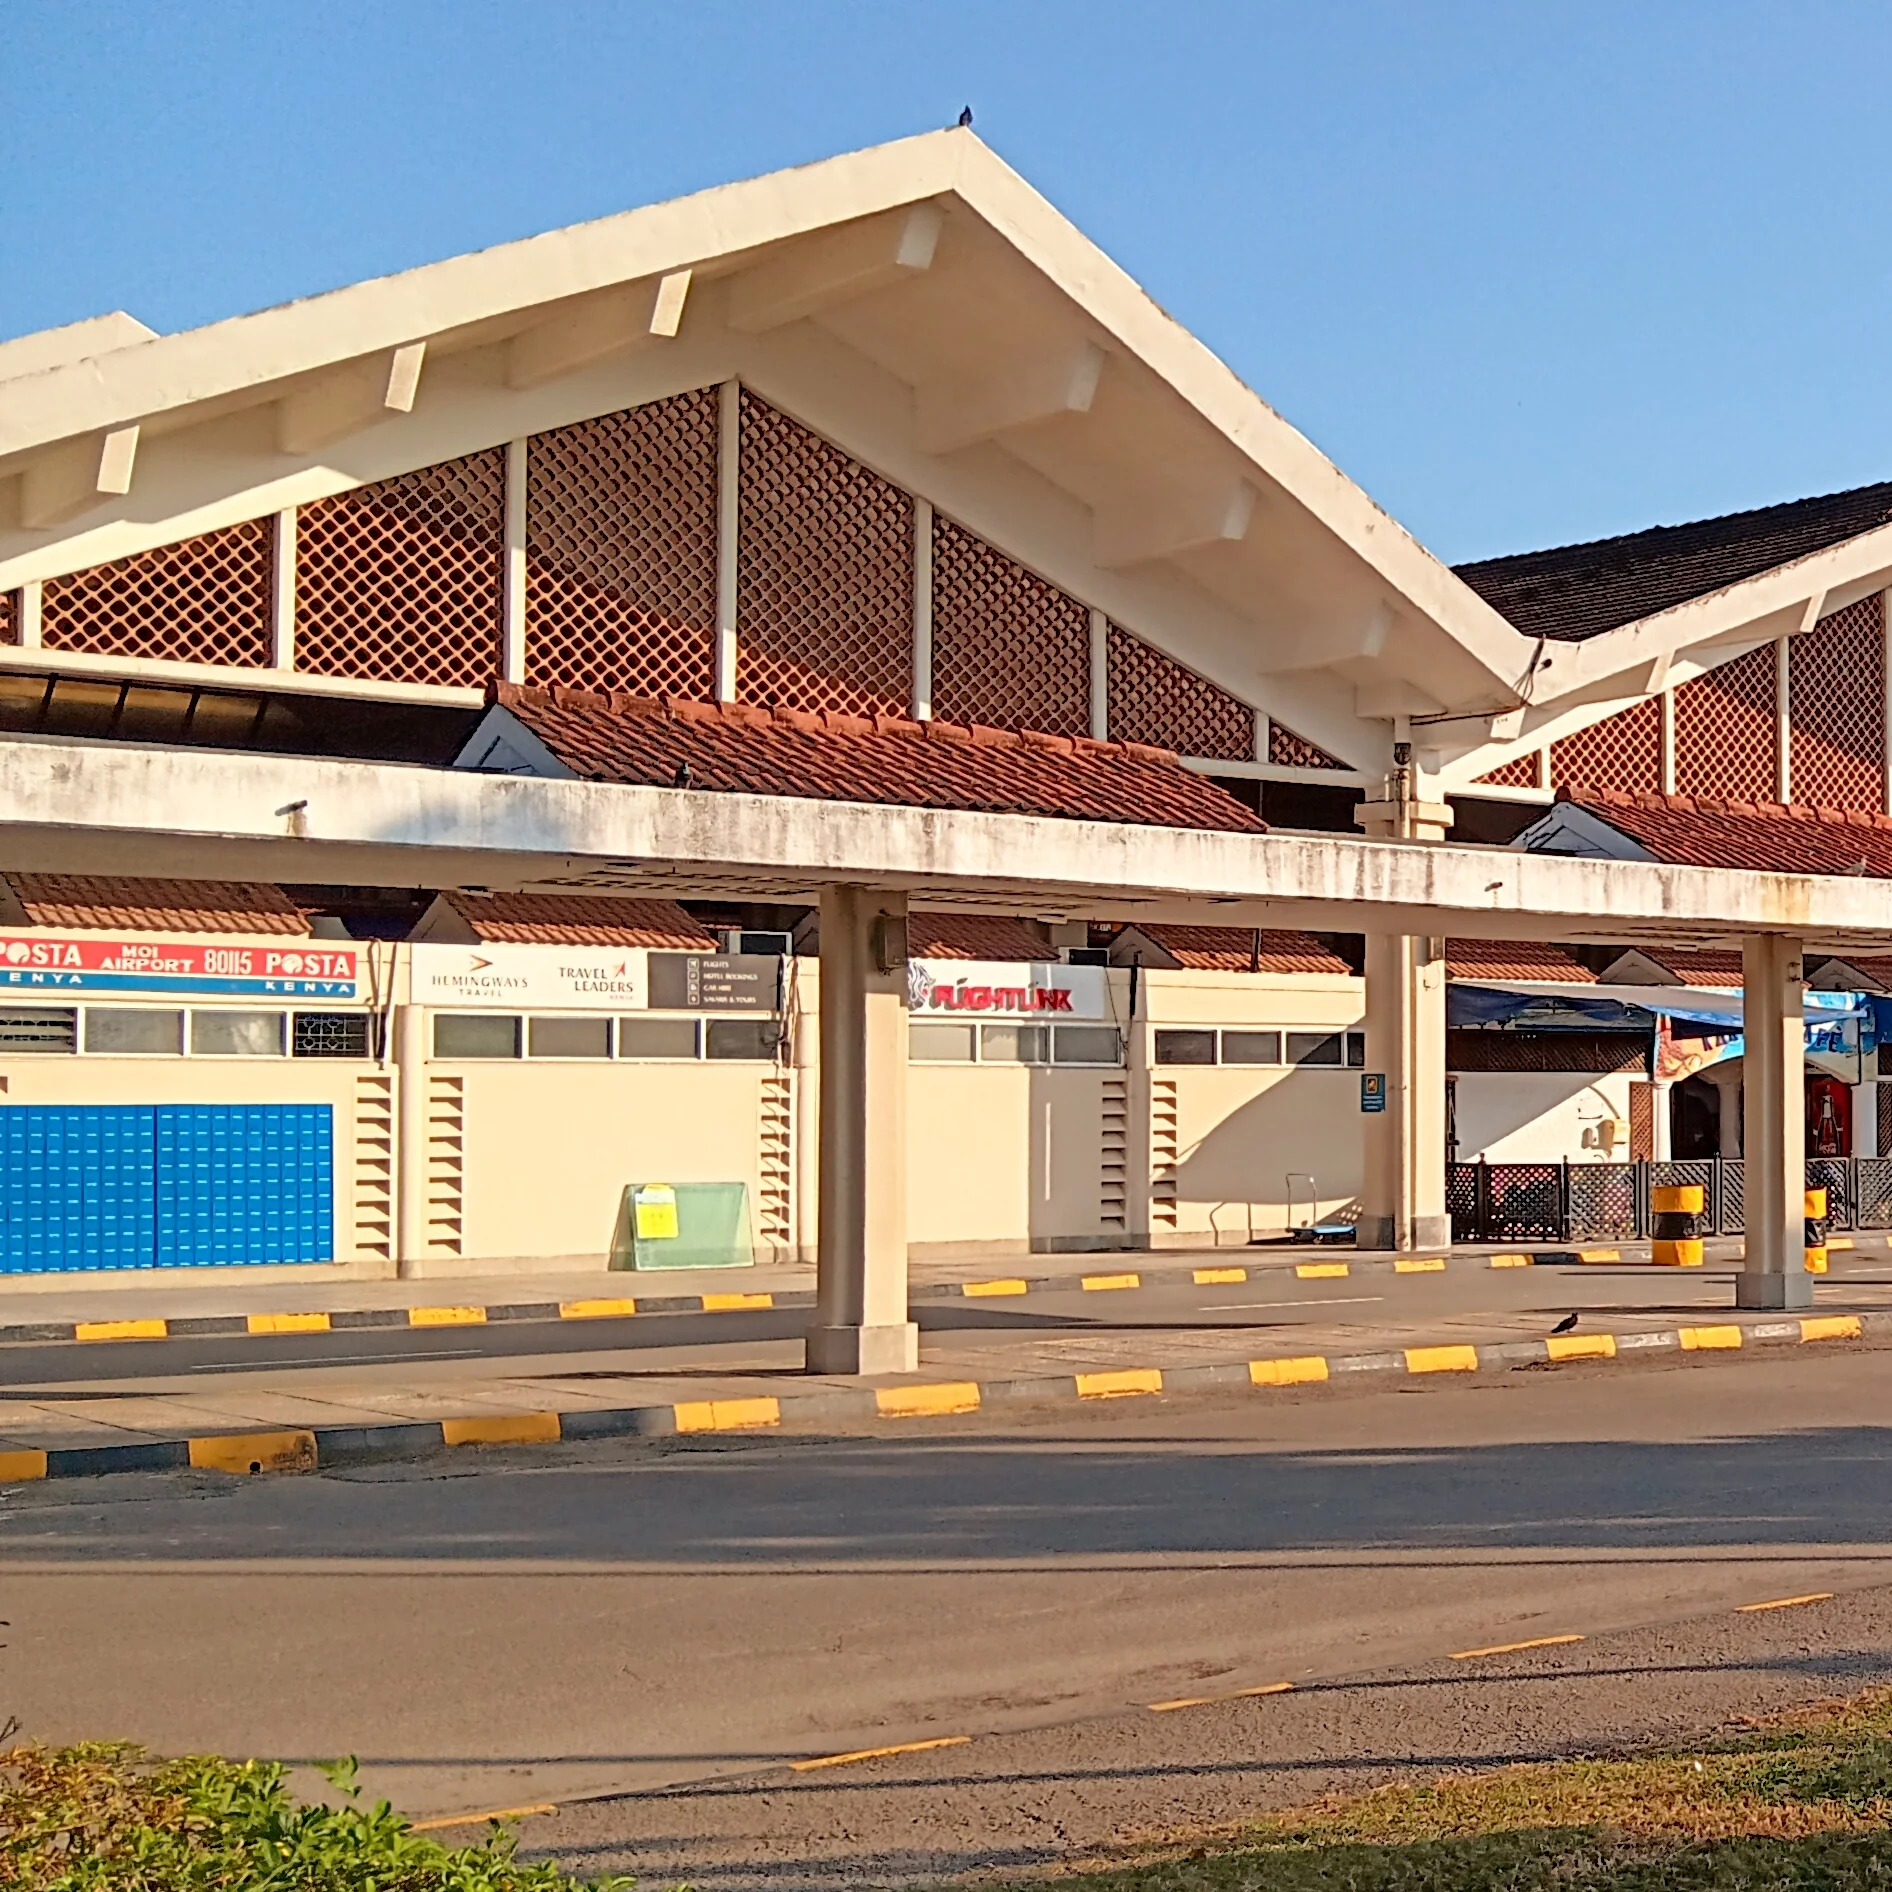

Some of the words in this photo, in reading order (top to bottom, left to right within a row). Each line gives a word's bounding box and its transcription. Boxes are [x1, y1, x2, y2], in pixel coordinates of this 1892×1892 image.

[121, 945, 159, 959] MOI
[100, 957, 194, 973] AIRPORT
[204, 949, 252, 975] 80115
[266, 952, 350, 977] POSTA
[9, 972, 83, 984] ENYA
[558, 967, 607, 980] TRAVEL
[265, 981, 350, 993] KENYA
[432, 975, 528, 988] HEMINGWAYS
[574, 980, 634, 993] LEADERS
[459, 988, 502, 997] TRAVEL
